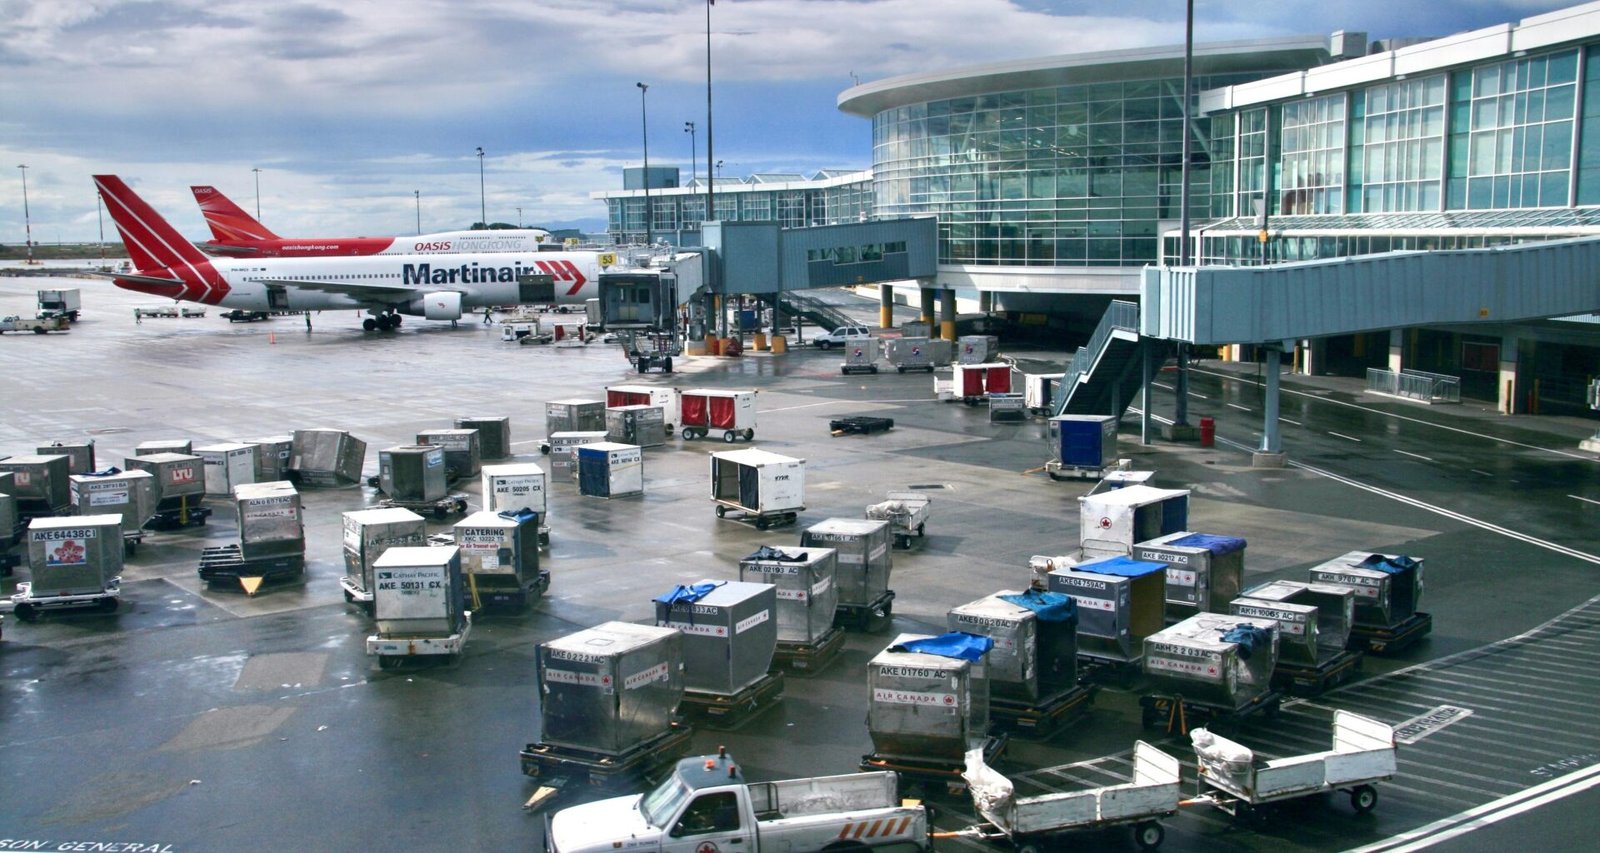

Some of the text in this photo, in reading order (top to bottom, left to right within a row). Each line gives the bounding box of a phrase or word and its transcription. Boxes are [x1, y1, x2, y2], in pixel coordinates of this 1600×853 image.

[281, 244, 340, 252] oasishongkong.com
[602, 255, 613, 264] 53
[403, 261, 534, 285] Martinair
[172, 468, 192, 481] LTU
[465, 528, 505, 536] CATERING
[379, 581, 441, 590] AKE 50131 CX
[1240, 607, 1257, 615] AKH
[1282, 612, 1293, 620] AC
[677, 624, 710, 633] CANADA
[1167, 662, 1202, 671] CANADA
[563, 673, 596, 682] CANADA
[881, 667, 946, 679] AKE 01760 AC
[896, 694, 937, 702] CANADA
[57, 841, 173, 853] GENERAL
